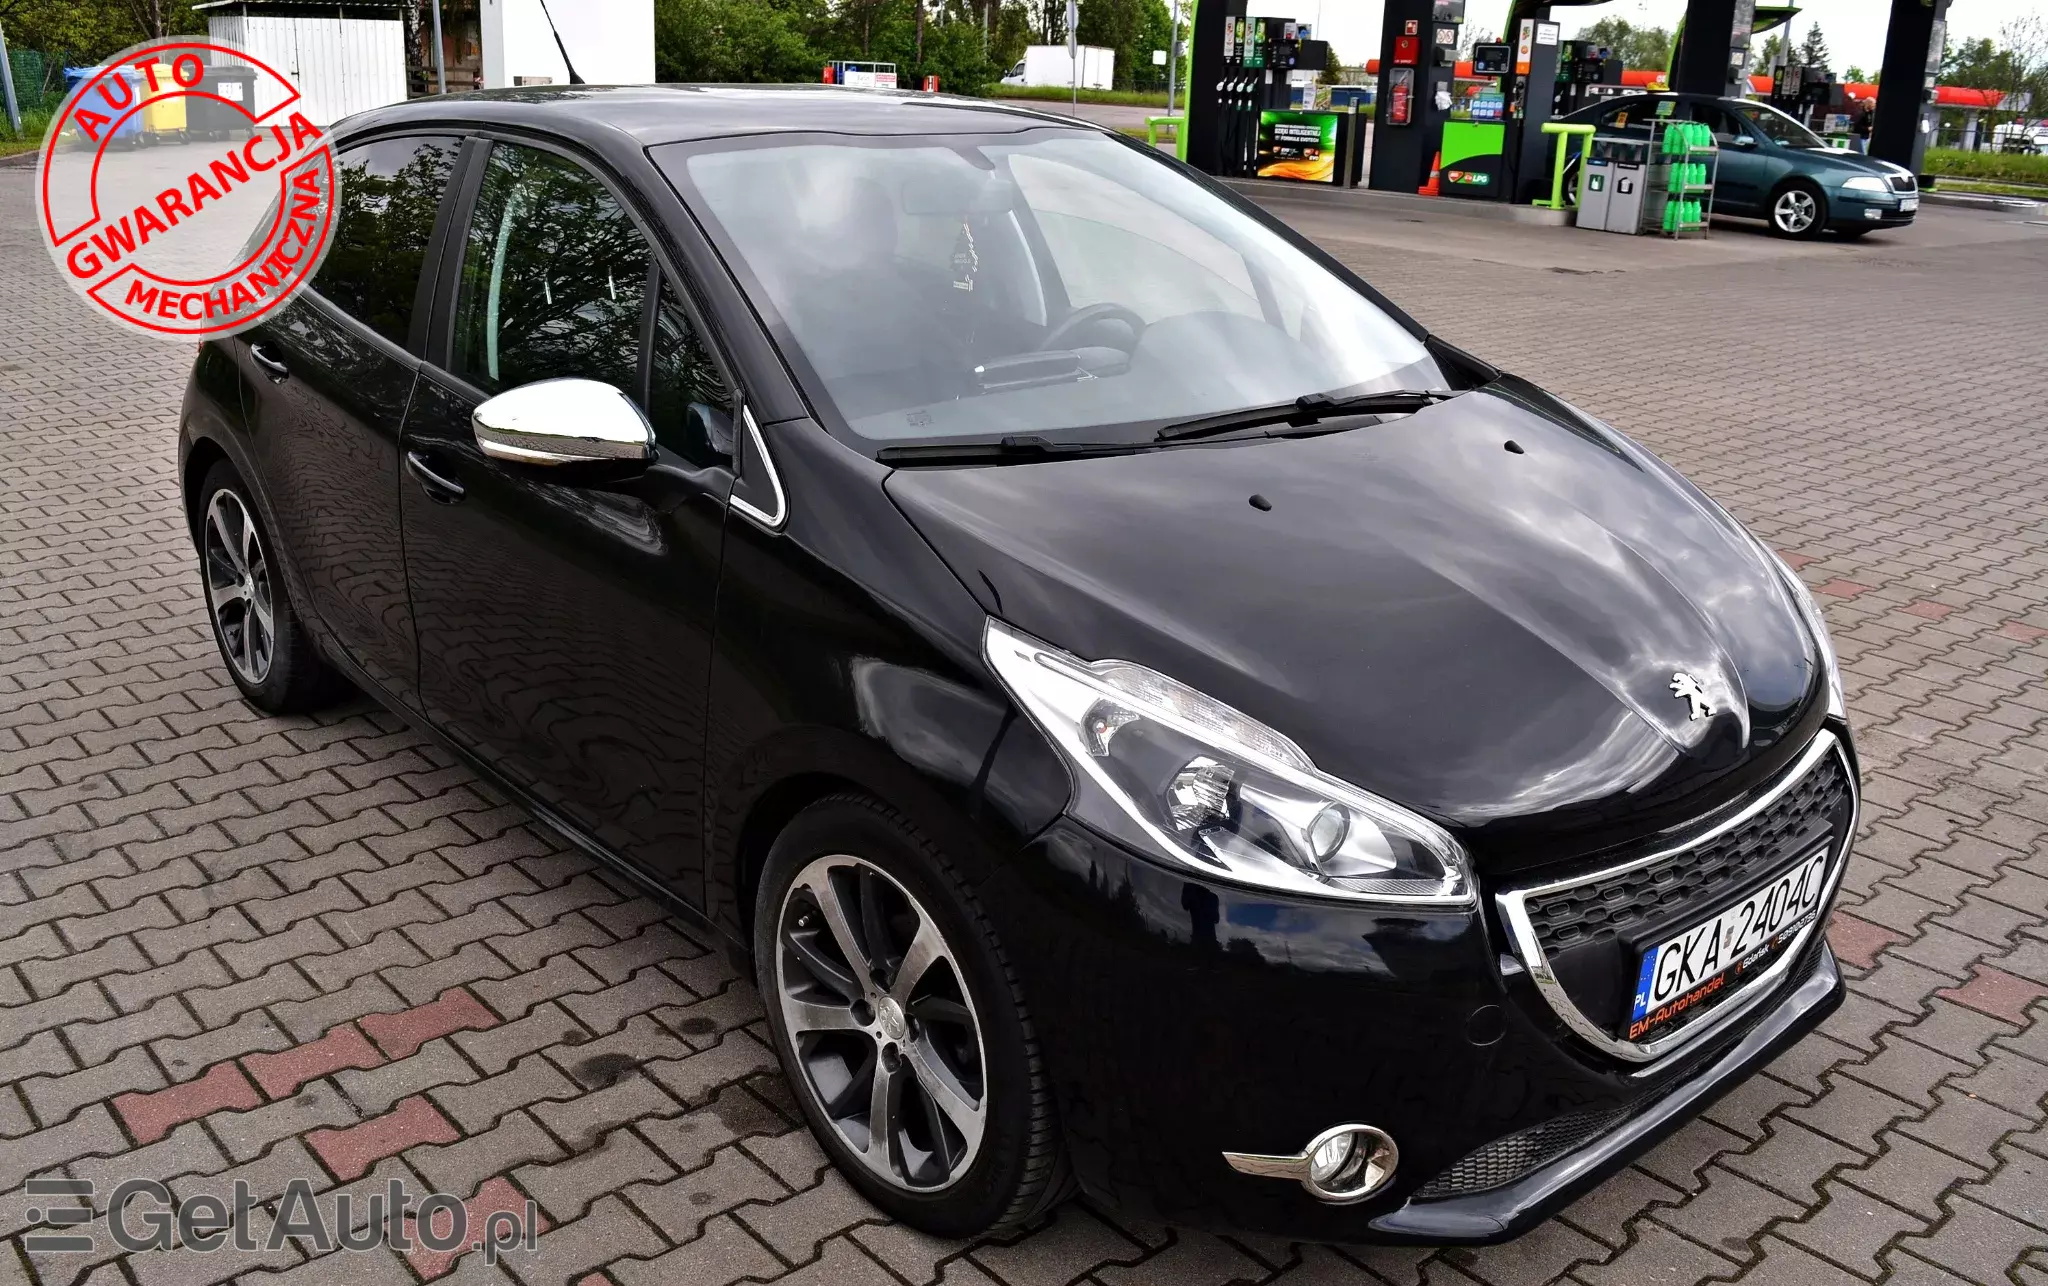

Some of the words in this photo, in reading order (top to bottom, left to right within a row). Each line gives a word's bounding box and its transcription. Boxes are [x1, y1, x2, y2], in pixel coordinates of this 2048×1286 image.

[1472, 174, 1488, 183] LPG
[1654, 918, 1722, 1002] GKA
[1730, 855, 1824, 960] 2404C
[1629, 972, 1725, 1040] EM-Autohandel
[1633, 991, 1646, 1011] PL
